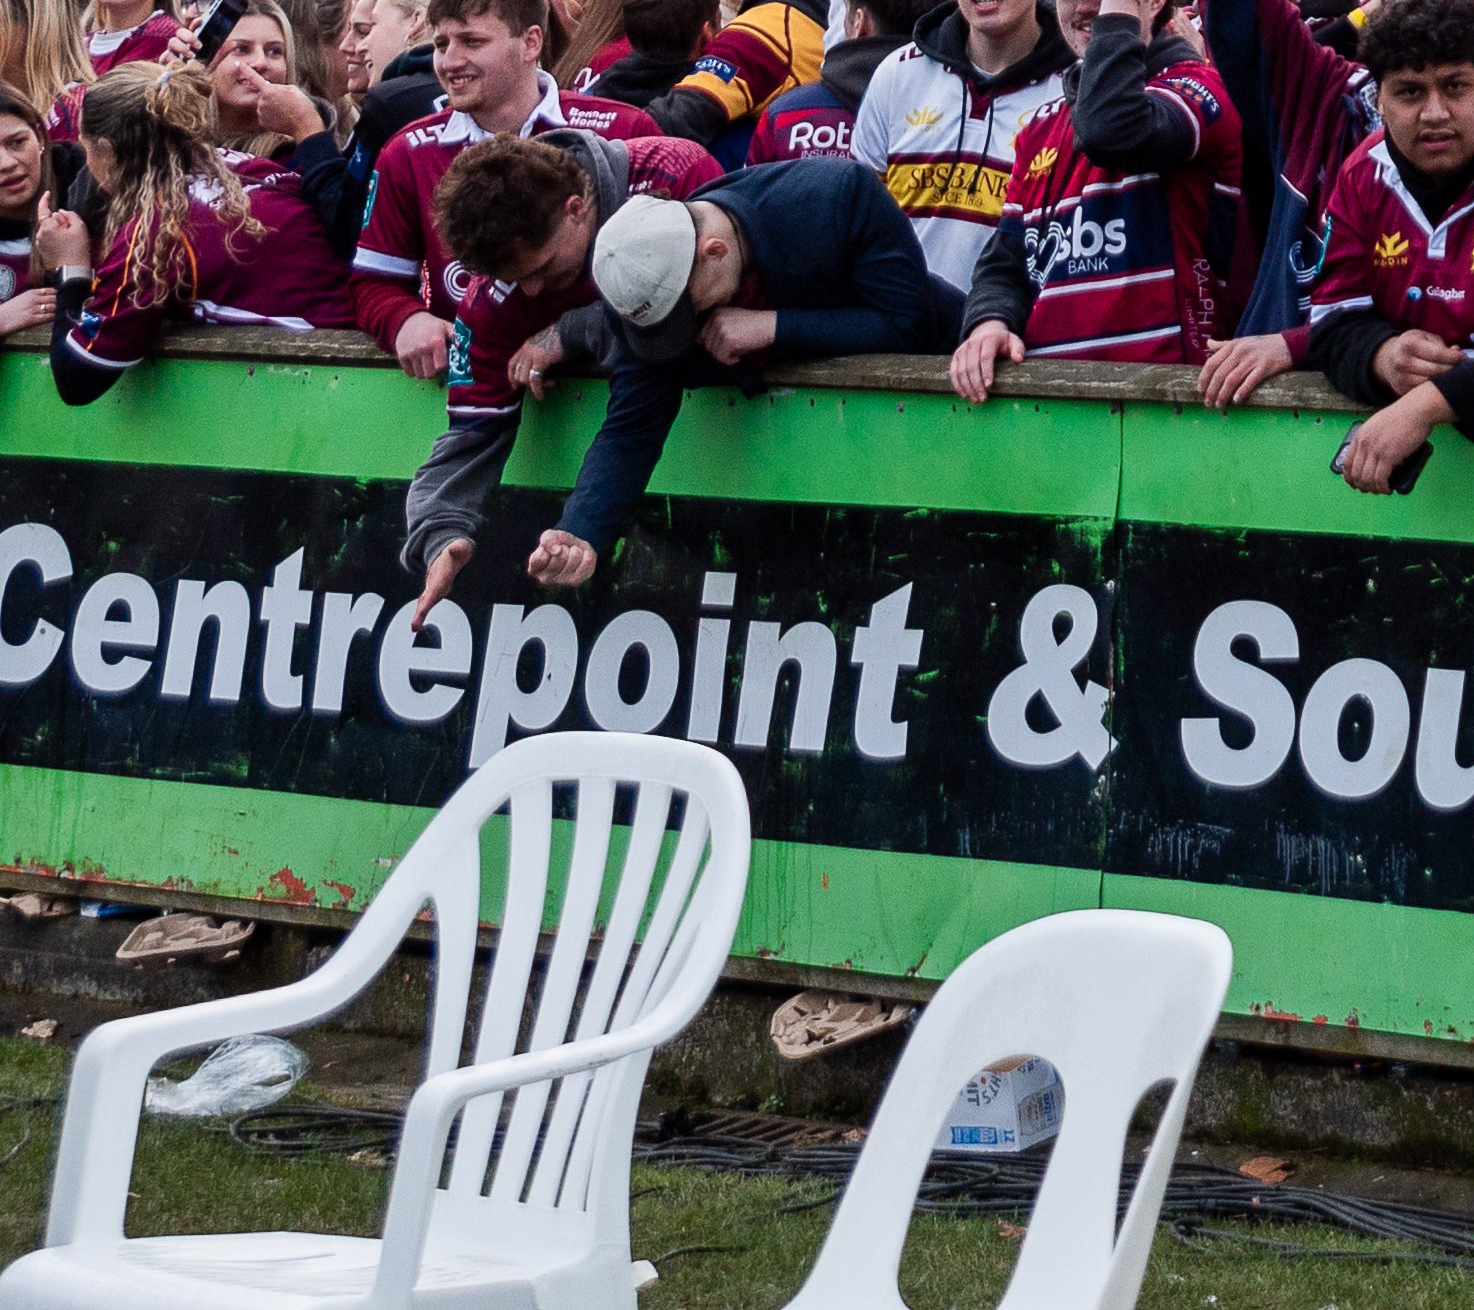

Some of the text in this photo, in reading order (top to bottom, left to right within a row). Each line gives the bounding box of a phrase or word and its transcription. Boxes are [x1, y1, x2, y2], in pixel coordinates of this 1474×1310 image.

[568, 106, 618, 122] Bennett
[569, 116, 611, 129] Homes
[1067, 256, 1109, 274] BANK
[0, 520, 925, 769] Centrepoint
[986, 583, 1121, 773] &
